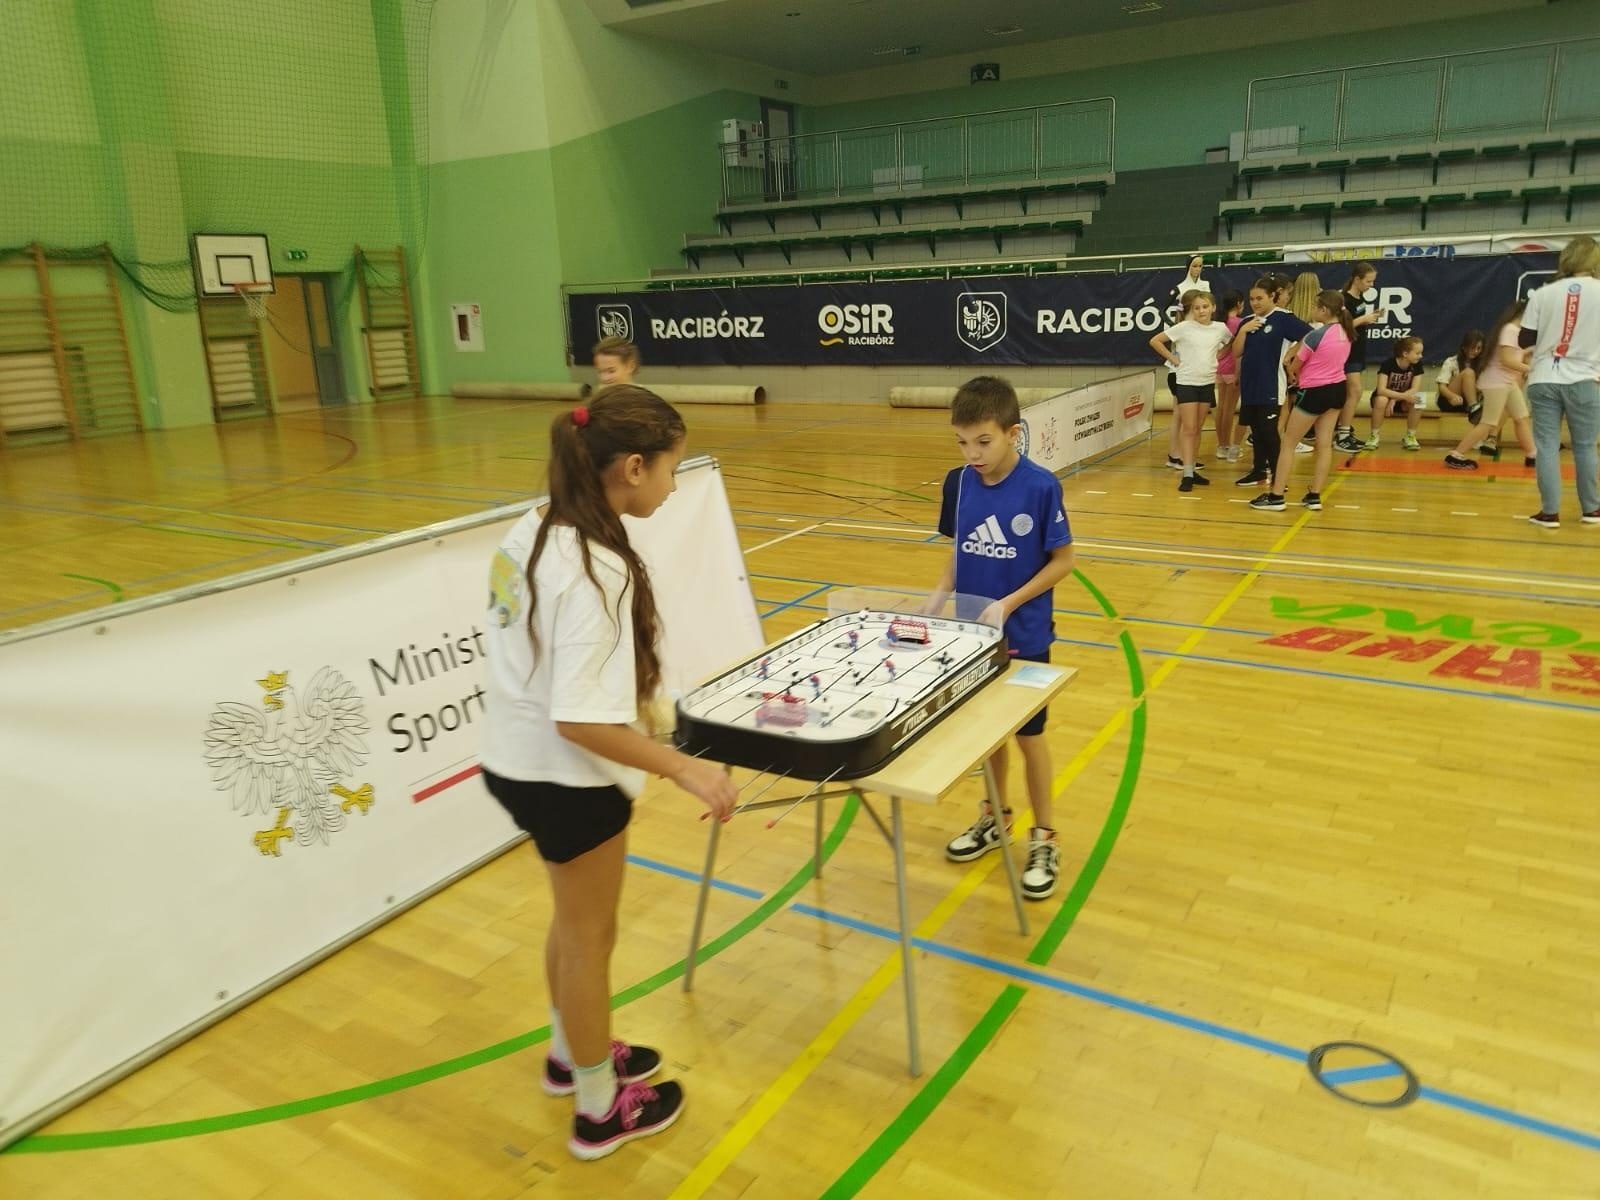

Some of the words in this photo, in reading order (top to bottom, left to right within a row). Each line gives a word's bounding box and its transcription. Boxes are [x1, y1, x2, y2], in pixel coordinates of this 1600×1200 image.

[818, 304, 894, 334] OSiR
[1363, 287, 1412, 324] iR
[1563, 295, 1578, 343] POLSKA
[651, 308, 765, 339] RACIBÓRZ
[848, 334, 894, 345] RACIBÓRZ
[1366, 325, 1412, 339] IBÓRZ
[962, 540, 1017, 558] adidas
[1270, 596, 1600, 650] ena
[369, 625, 486, 696] Minist
[387, 684, 486, 752] Sport
